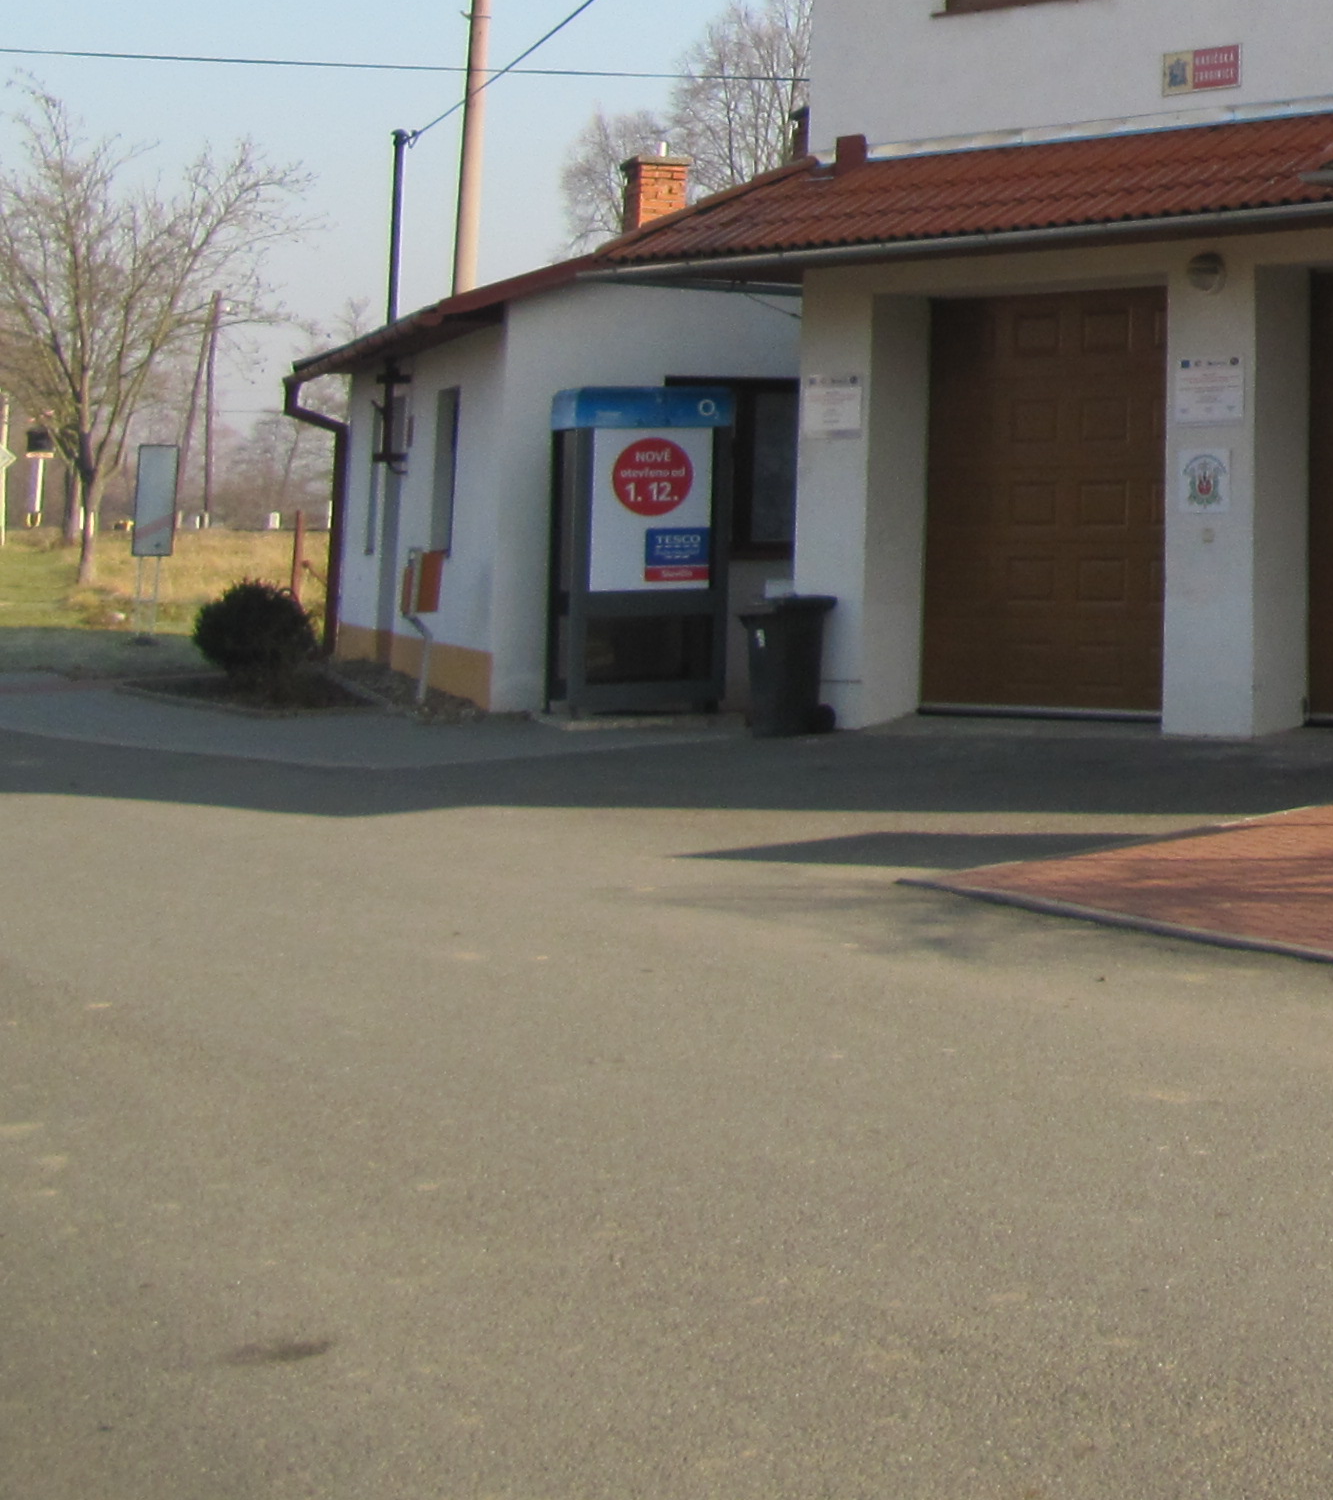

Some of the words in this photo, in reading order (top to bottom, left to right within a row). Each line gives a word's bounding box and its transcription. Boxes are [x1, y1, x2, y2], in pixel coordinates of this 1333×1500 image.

[620, 467, 670, 478] otevřeno
[671, 466, 686, 478] od
[625, 481, 643, 502] 1.
[648, 480, 679, 502] 12.
[655, 535, 701, 545] TESCO
